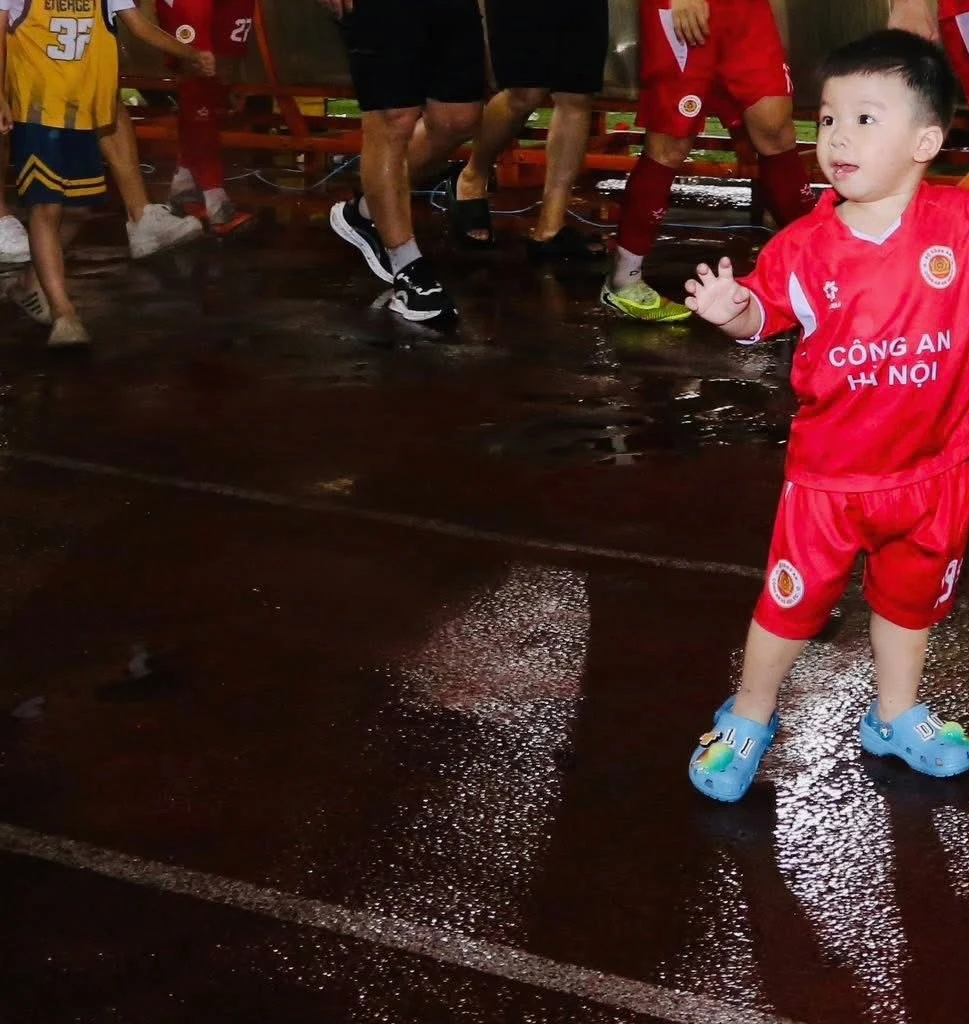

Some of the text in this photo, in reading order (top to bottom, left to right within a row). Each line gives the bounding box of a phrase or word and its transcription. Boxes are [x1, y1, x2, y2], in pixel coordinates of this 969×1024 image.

[230, 18, 252, 42] 27
[828, 329, 951, 367] CÔNG AN
[888, 360, 937, 388] NỘI
